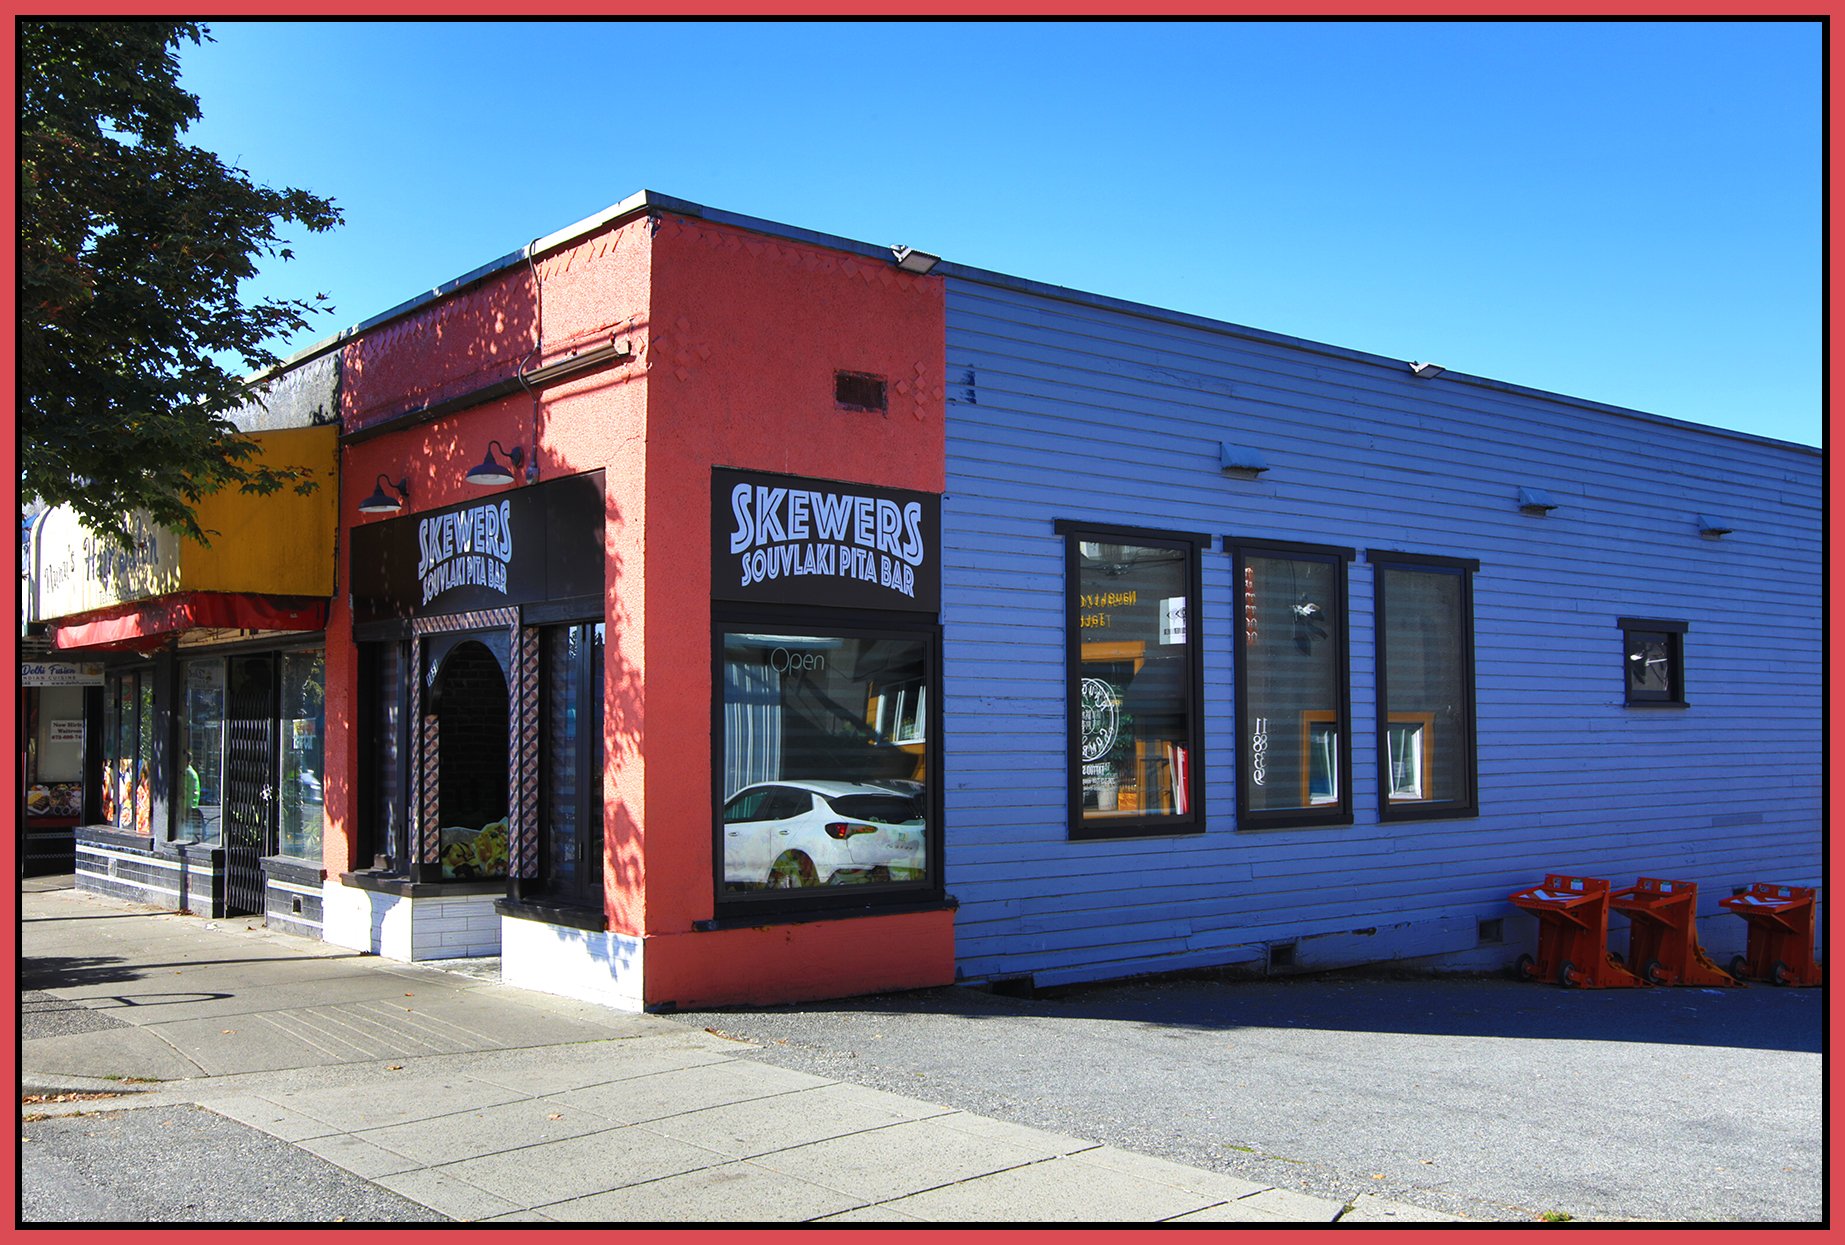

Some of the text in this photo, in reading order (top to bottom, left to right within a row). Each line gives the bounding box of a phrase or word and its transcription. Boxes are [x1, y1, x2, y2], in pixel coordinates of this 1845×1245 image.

[418, 499, 512, 580] SKEWERS
[731, 483, 924, 566] SKEWERS
[422, 555, 507, 606] SOUVLAKI PITA BAR
[741, 543, 915, 598] SOUVLAKI PITA BAR
[48, 663, 76, 675] Fusion
[771, 646, 825, 676] Open
